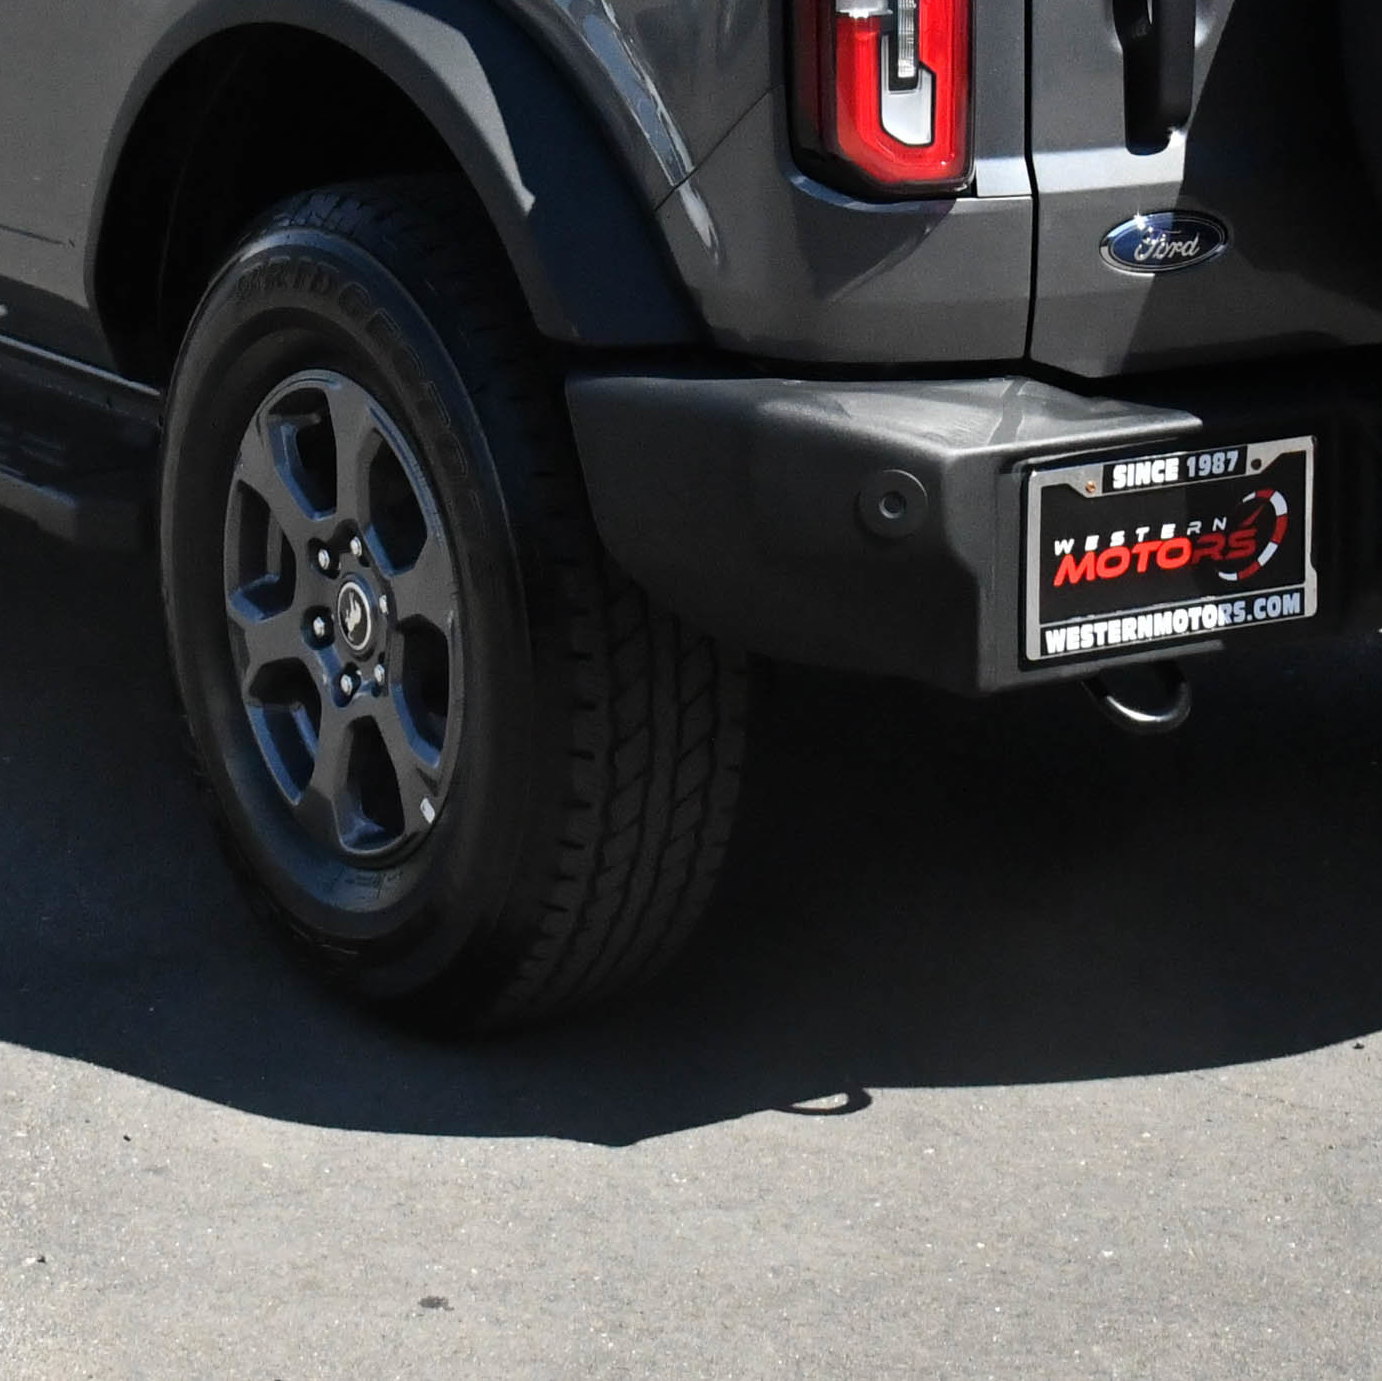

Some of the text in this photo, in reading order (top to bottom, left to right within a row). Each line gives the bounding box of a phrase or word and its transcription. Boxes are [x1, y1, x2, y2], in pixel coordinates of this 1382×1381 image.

[1133, 225, 1200, 262] Ford
[1112, 450, 1239, 489] SINCE 1987
[1053, 517, 1227, 556] WESTERN
[1053, 528, 1258, 587] MOTORS
[1044, 592, 1301, 654] WESTERNMOTORS.COM
